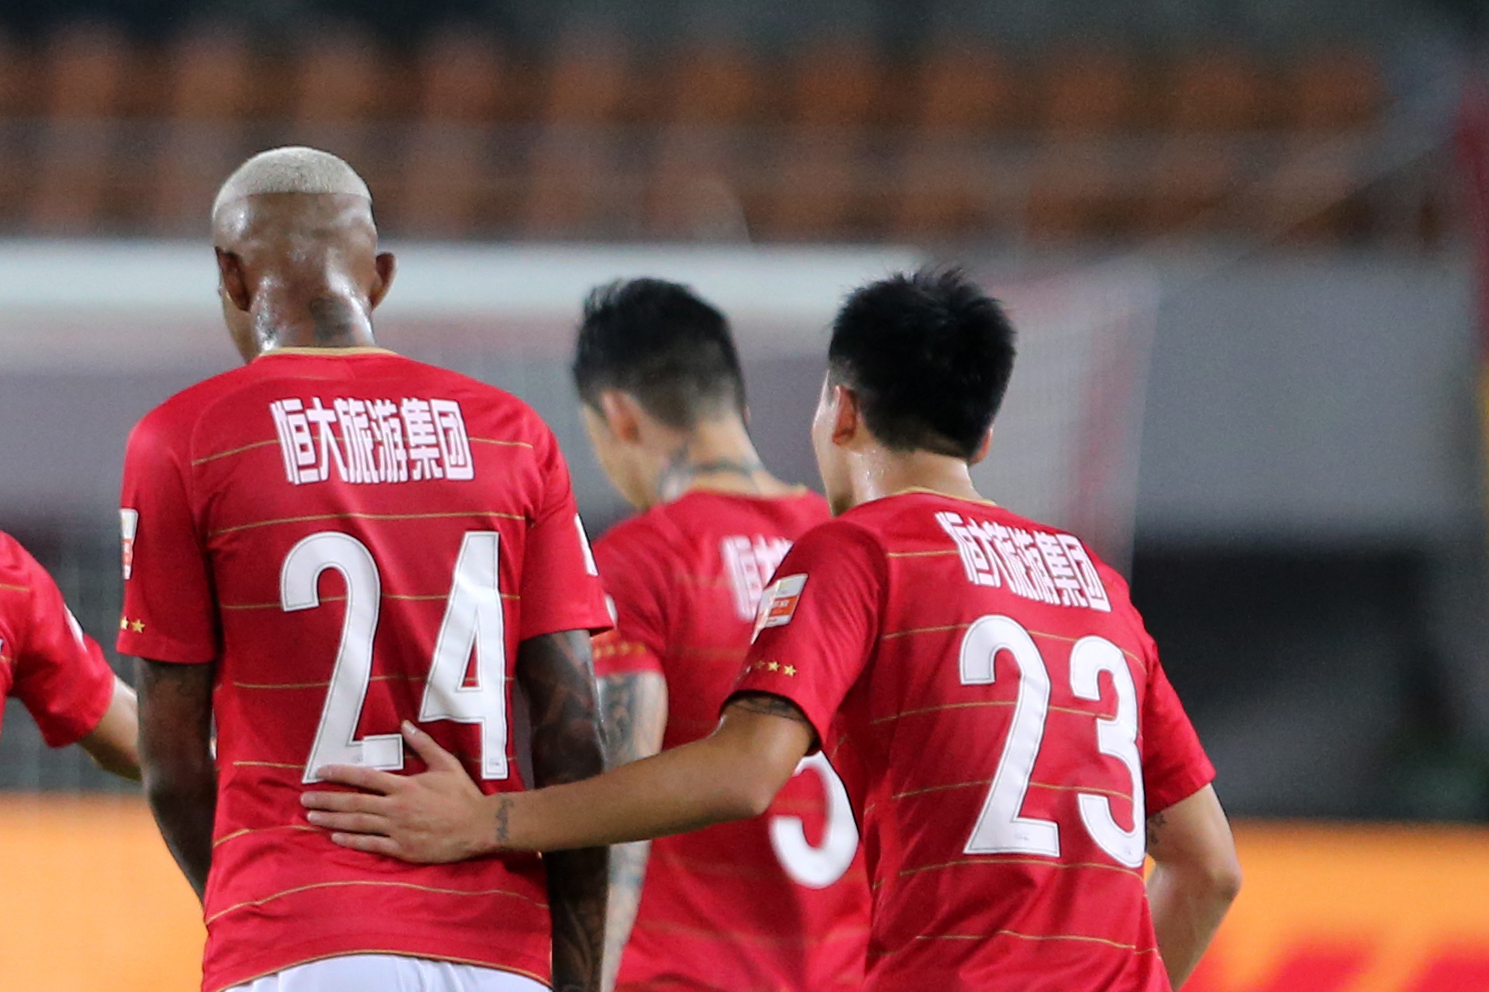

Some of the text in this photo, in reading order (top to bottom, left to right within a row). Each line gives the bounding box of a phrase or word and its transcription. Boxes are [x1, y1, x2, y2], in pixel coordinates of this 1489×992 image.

[269, 397, 475, 485] 恒大旅游集团
[720, 533, 795, 620] 恒大
[934, 511, 1112, 613] 恒大旅游集团
[280, 530, 508, 784] 24
[958, 614, 1146, 868] 23
